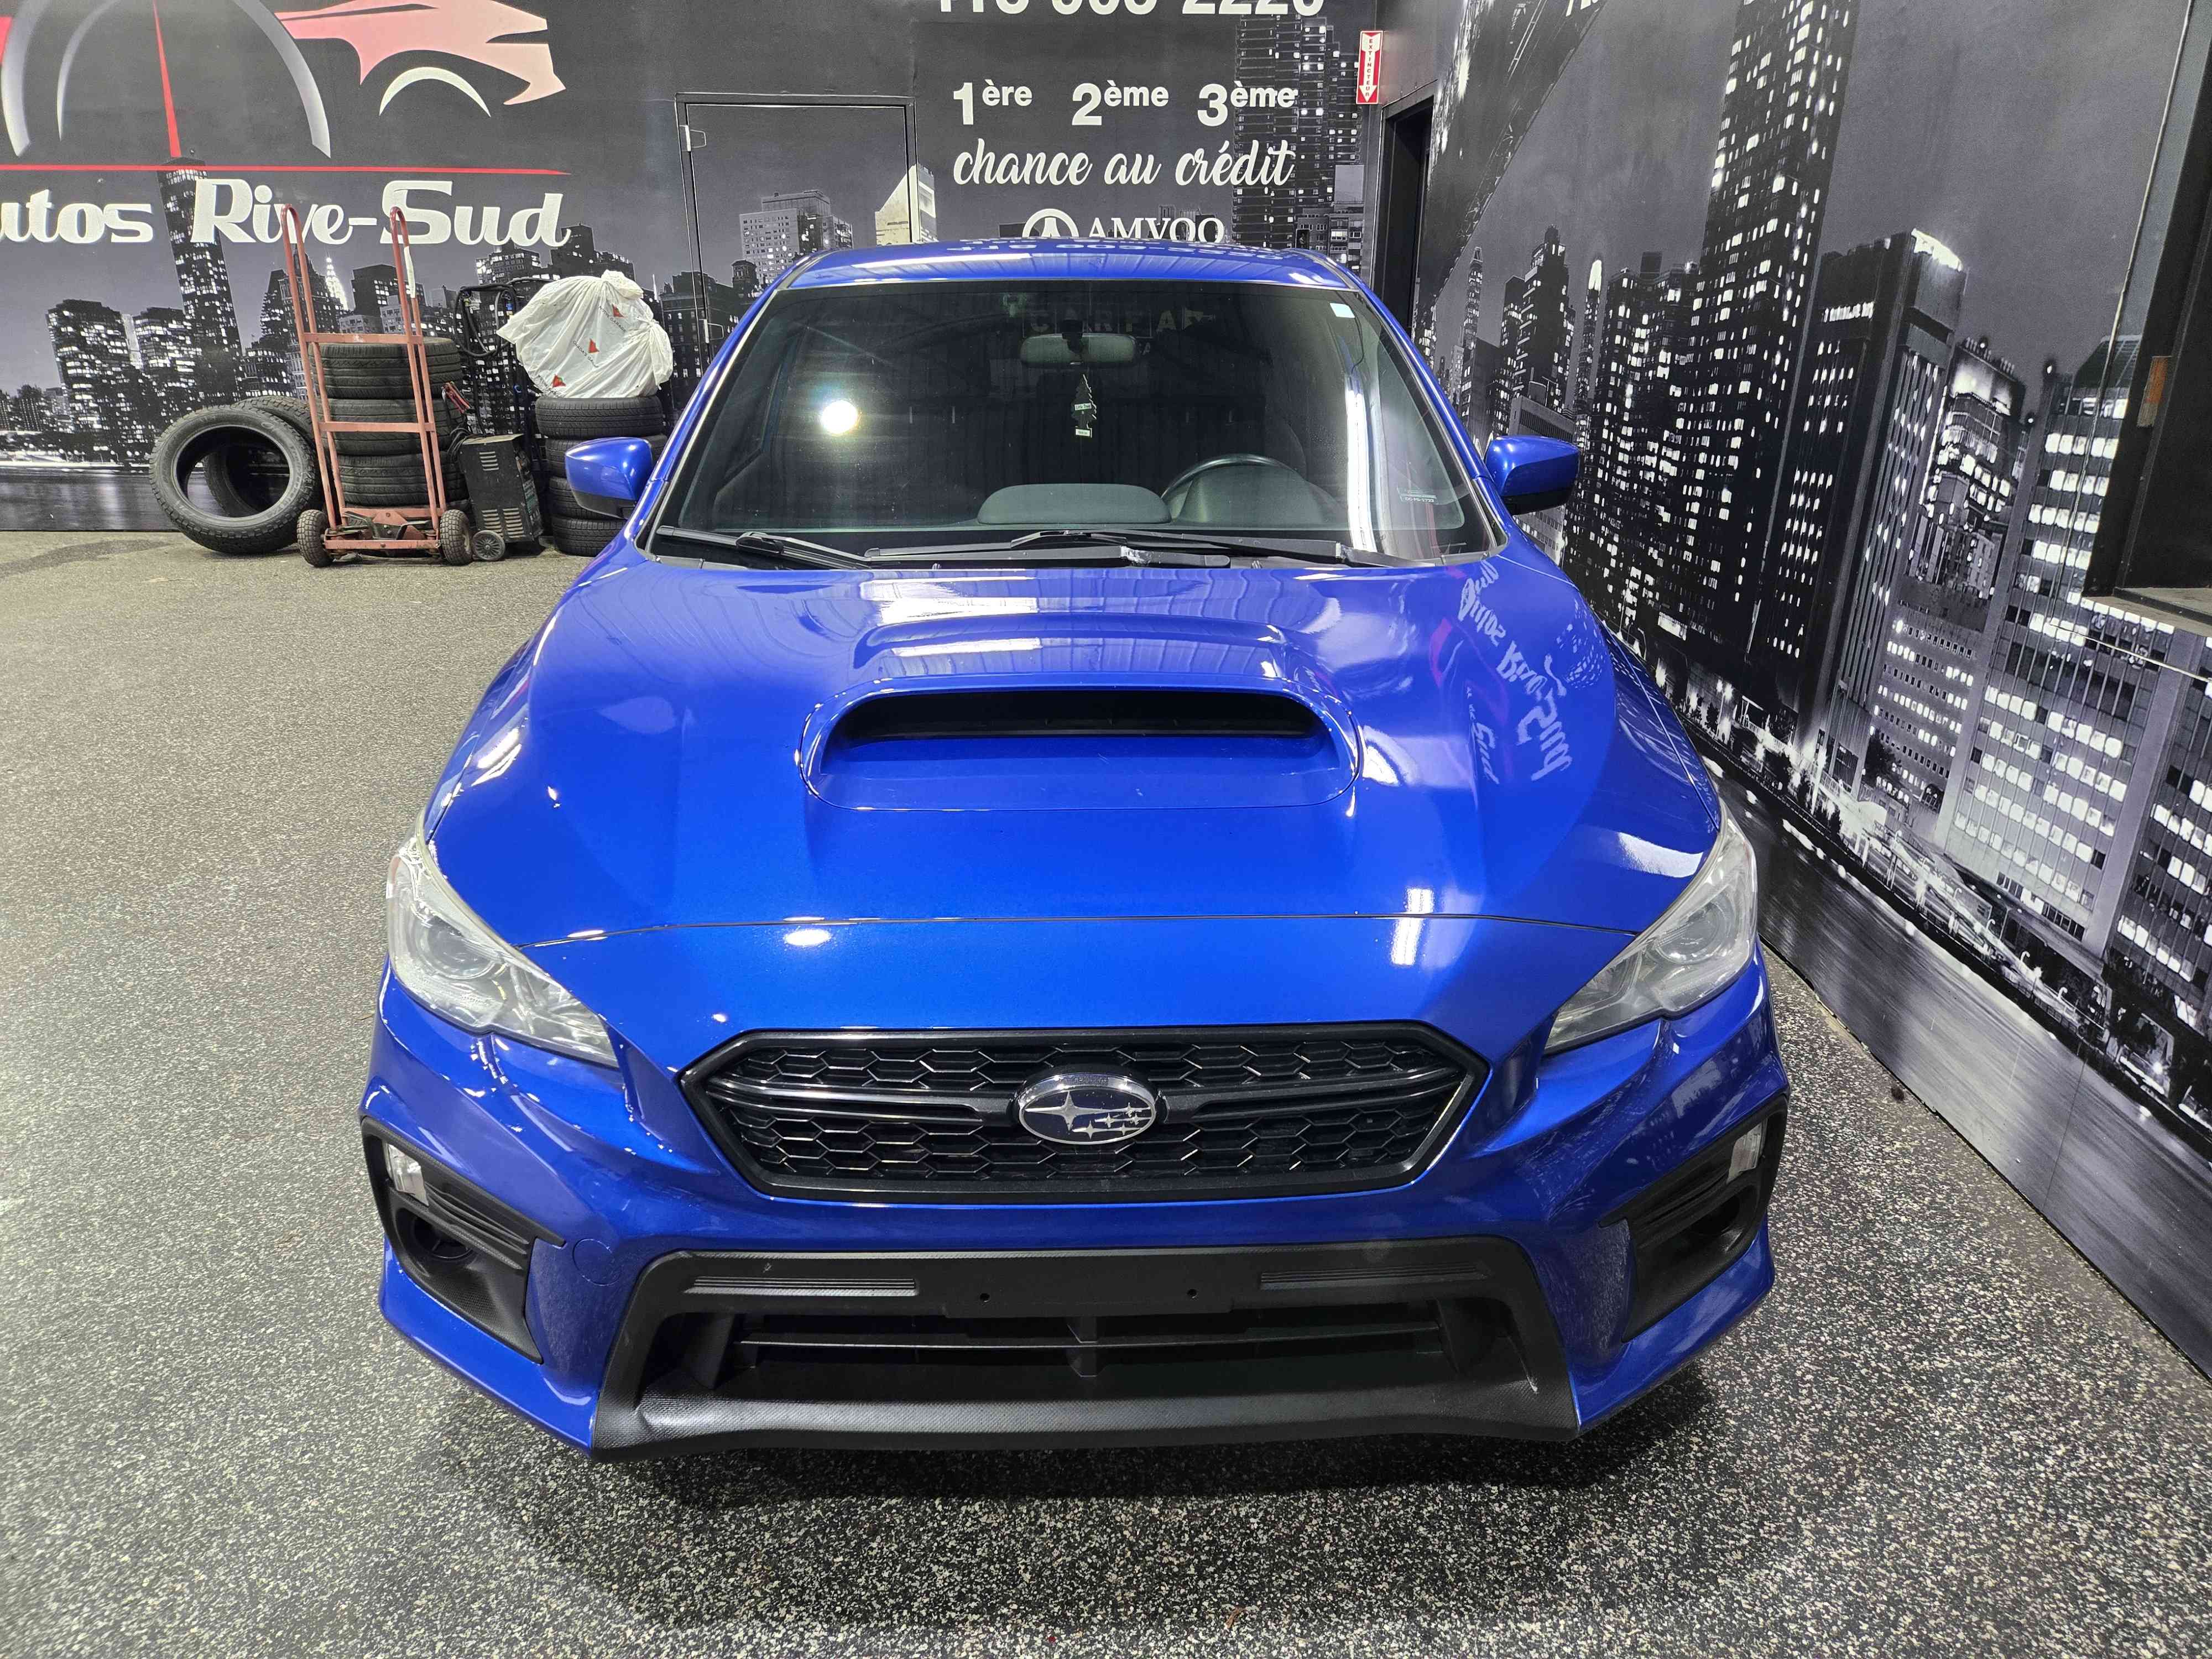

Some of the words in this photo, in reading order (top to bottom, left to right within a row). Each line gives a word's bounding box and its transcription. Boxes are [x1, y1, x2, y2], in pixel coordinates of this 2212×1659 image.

[953, 80, 1032, 126] 1ère
[1071, 80, 1169, 126] 2ème
[1197, 80, 1296, 127] 3ème
[953, 138, 1093, 186] chance
[1104, 152, 1162, 186] au
[1175, 139, 1296, 186] crédit
[0, 189, 154, 244] utos
[191, 178, 571, 247] Rive-Sud
